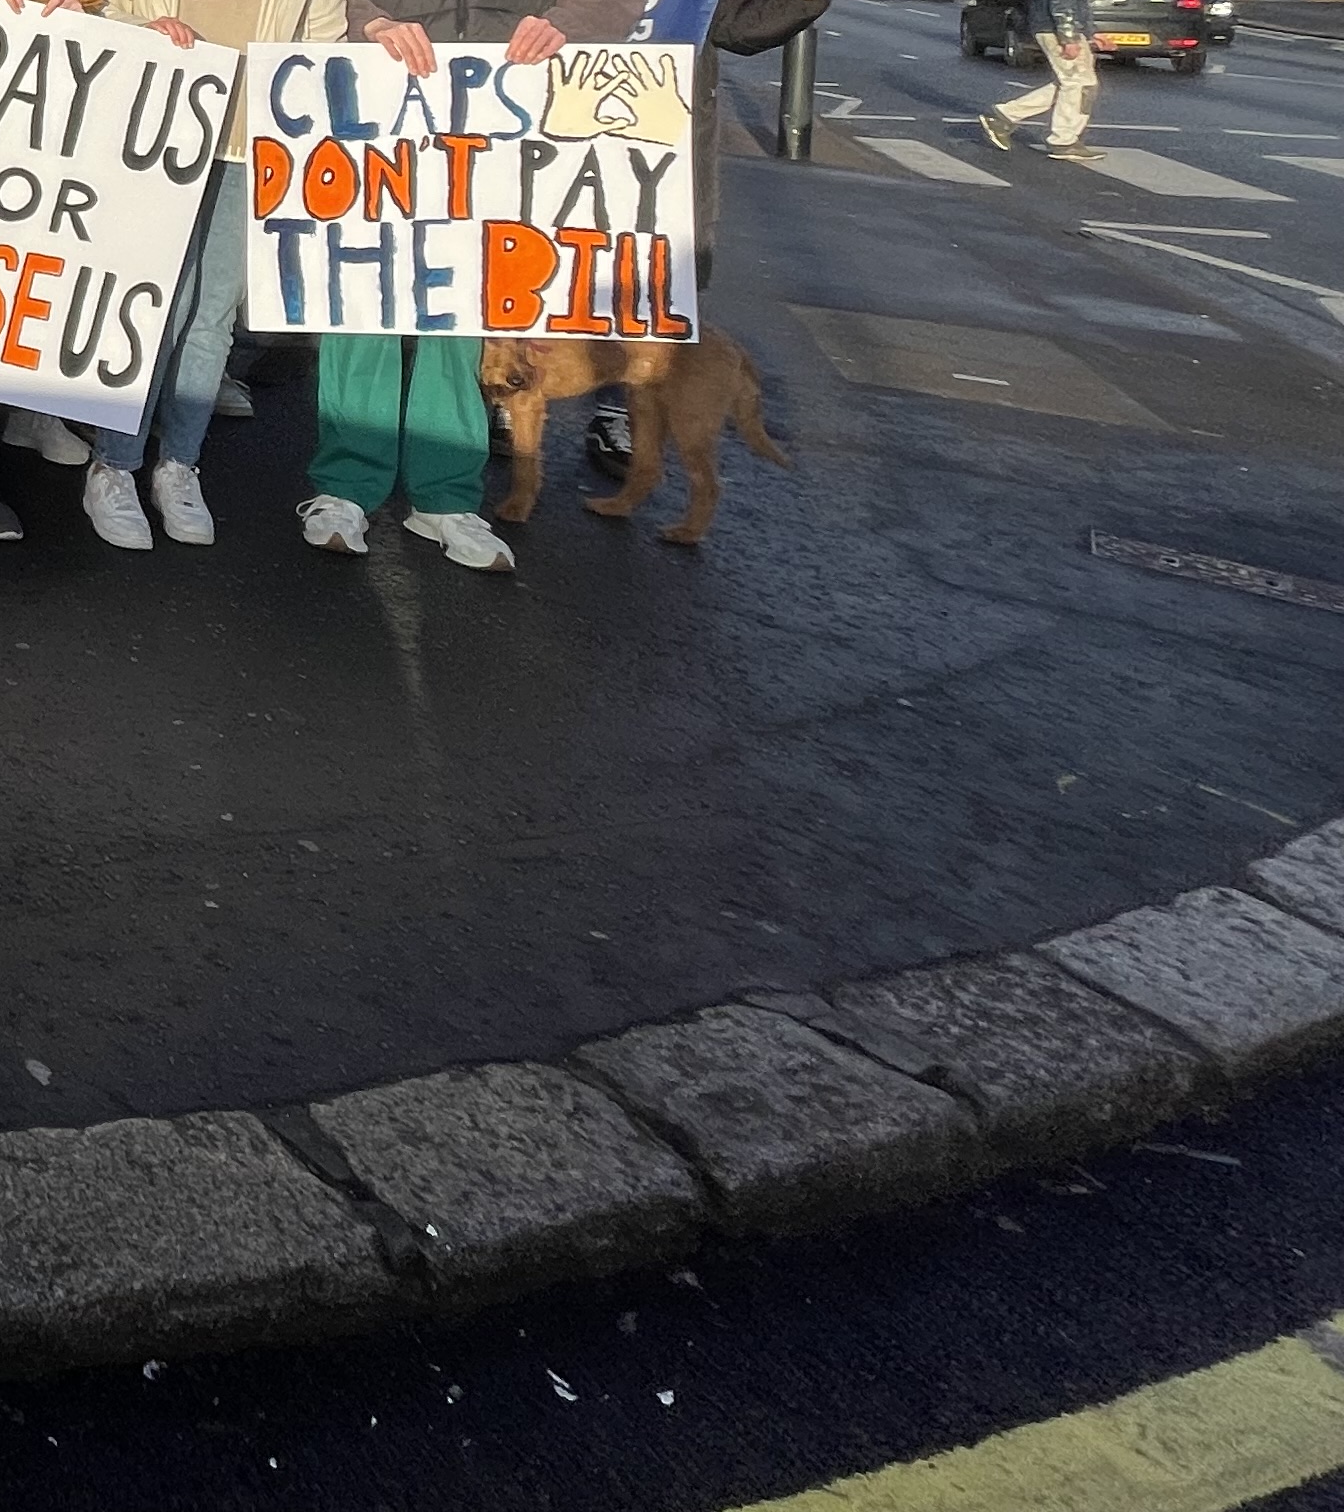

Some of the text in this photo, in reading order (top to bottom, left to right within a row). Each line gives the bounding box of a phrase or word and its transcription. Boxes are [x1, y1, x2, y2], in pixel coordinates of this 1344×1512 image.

[121, 60, 228, 186] US
[270, 54, 533, 141] CLAPS
[253, 133, 677, 233] DON'T PAY
[58, 266, 163, 388] US
[264, 218, 693, 342] THE BILL
